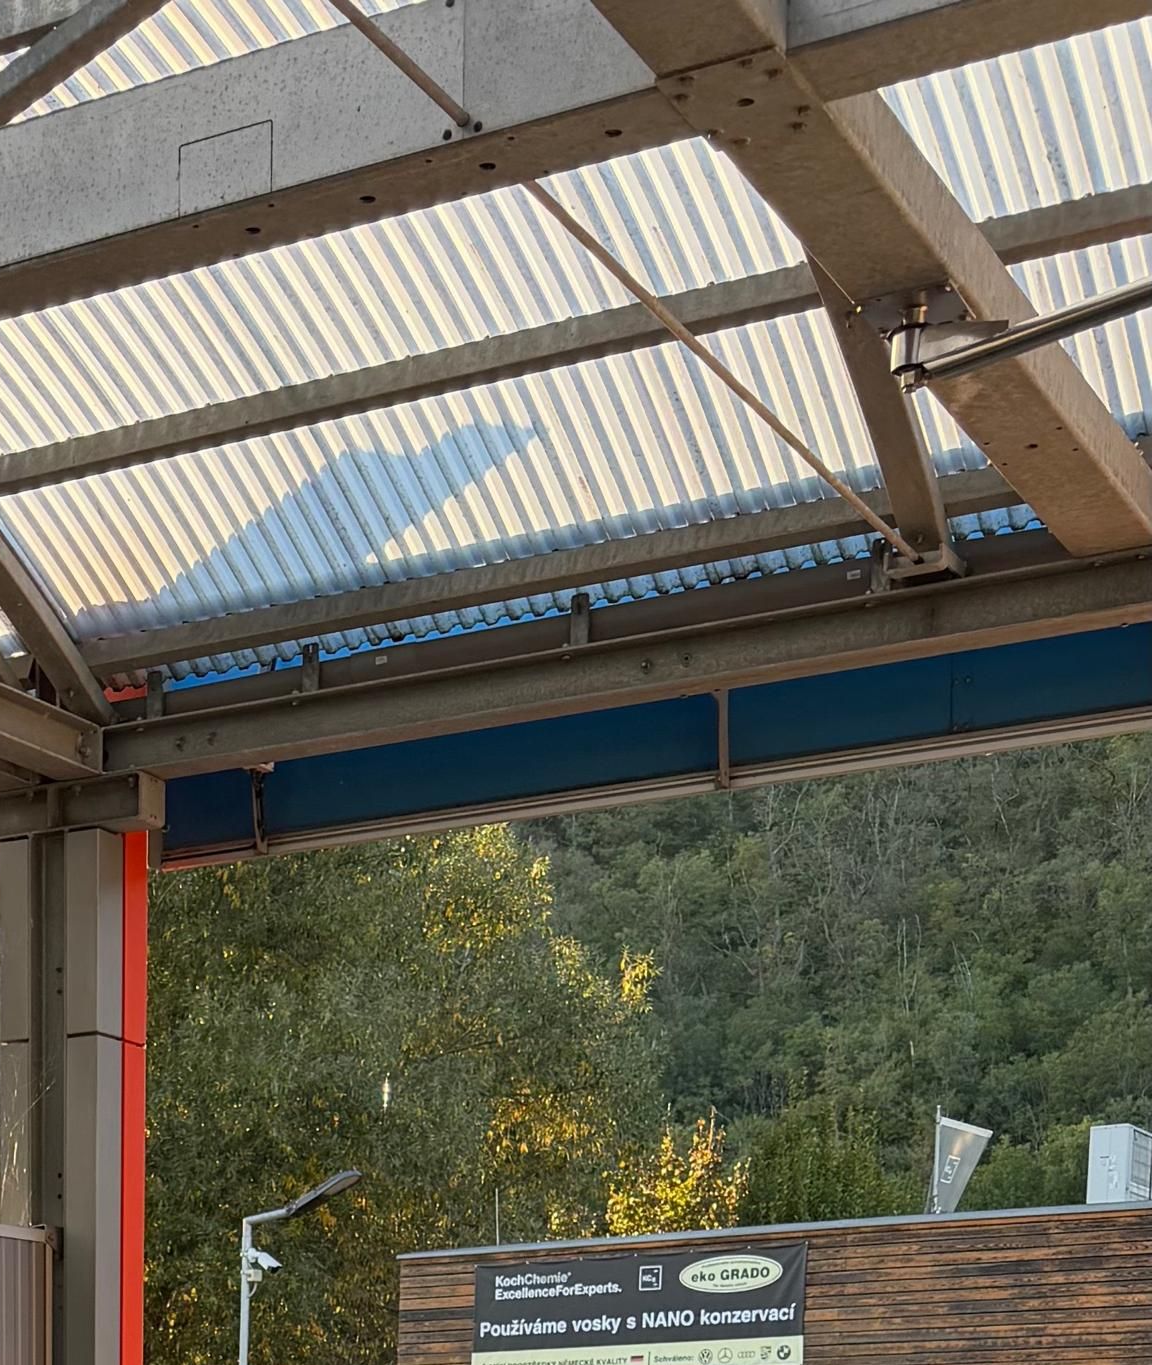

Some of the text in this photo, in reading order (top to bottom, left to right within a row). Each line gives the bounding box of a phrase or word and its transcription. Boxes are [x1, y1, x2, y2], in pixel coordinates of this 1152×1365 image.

[691, 1266, 770, 1282] eko GRADO
[495, 1281, 622, 1300] ExcellenceForExperts.
[480, 1303, 796, 1338] Používáme vosky s NANO konzervací
